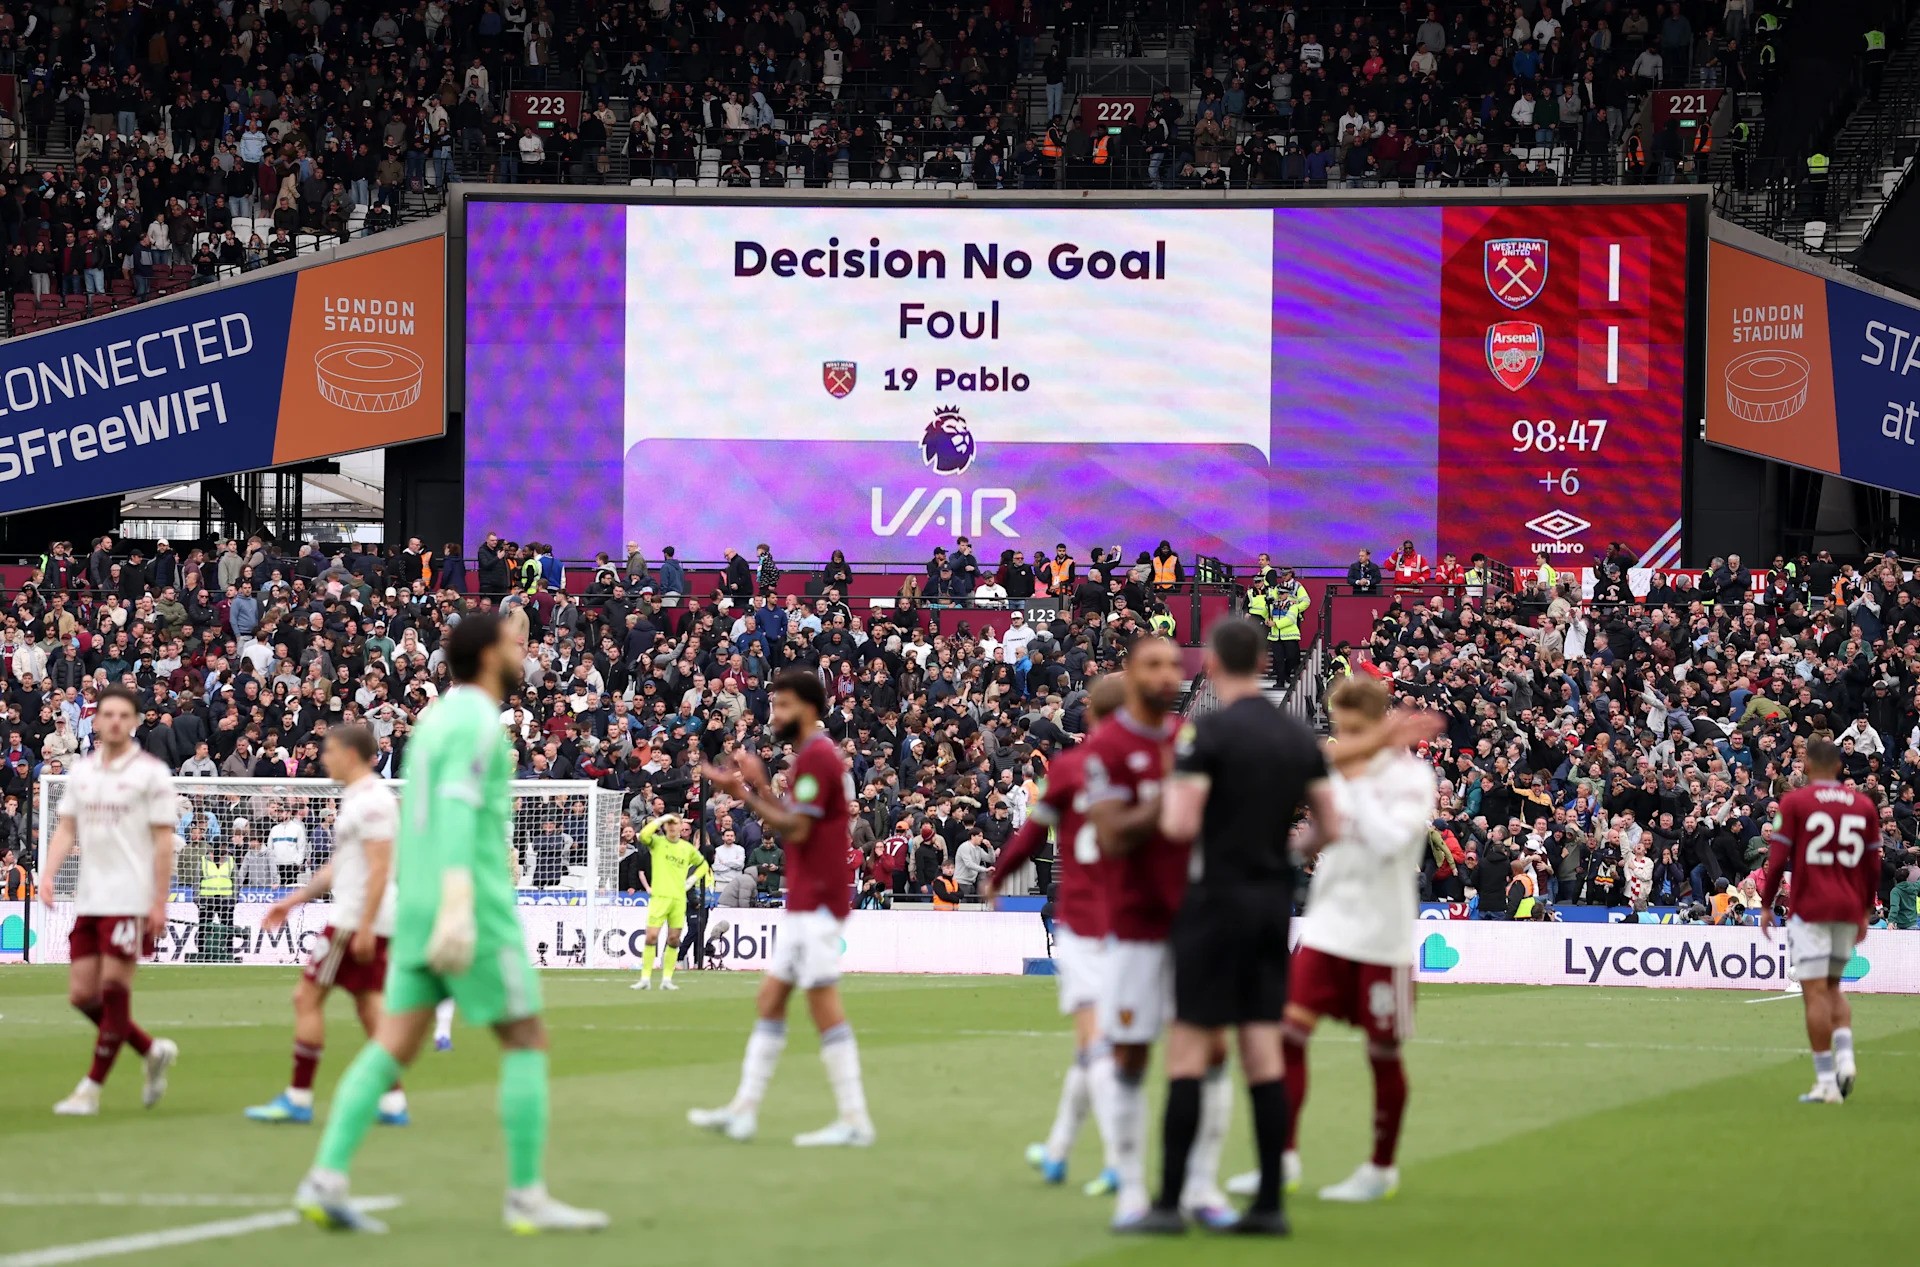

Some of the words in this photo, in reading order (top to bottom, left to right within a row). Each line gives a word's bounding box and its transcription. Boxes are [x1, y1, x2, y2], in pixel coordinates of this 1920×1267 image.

[527, 96, 565, 115] 223
[1097, 102, 1135, 121] 222
[1669, 95, 1707, 114] 221
[1492, 242, 1517, 251] WEST
[1518, 242, 1541, 251] HAM
[734, 237, 946, 278] Decision
[964, 243, 1032, 279] No
[1048, 240, 1165, 280] Goal
[324, 296, 415, 317] LONDON
[1733, 304, 1804, 324] LONDON
[324, 315, 415, 335] STADIUM
[900, 300, 999, 339] Foul
[1494, 332, 1537, 344] Arsenal
[1732, 323, 1804, 343] STADIUM
[0, 312, 254, 417] ONNECTED
[884, 367, 918, 391] 19
[936, 366, 1030, 392] Pablo
[1881, 400, 1920, 446] at
[1511, 419, 1608, 452] 98:47
[1538, 467, 1580, 496] +6
[871, 487, 1021, 538] VAR
[1531, 540, 1584, 554] umbro
[1027, 608, 1056, 623] 123
[885, 841, 904, 857] 17
[1805, 811, 1867, 868] 25
[1565, 938, 1786, 983] LycaMobi
